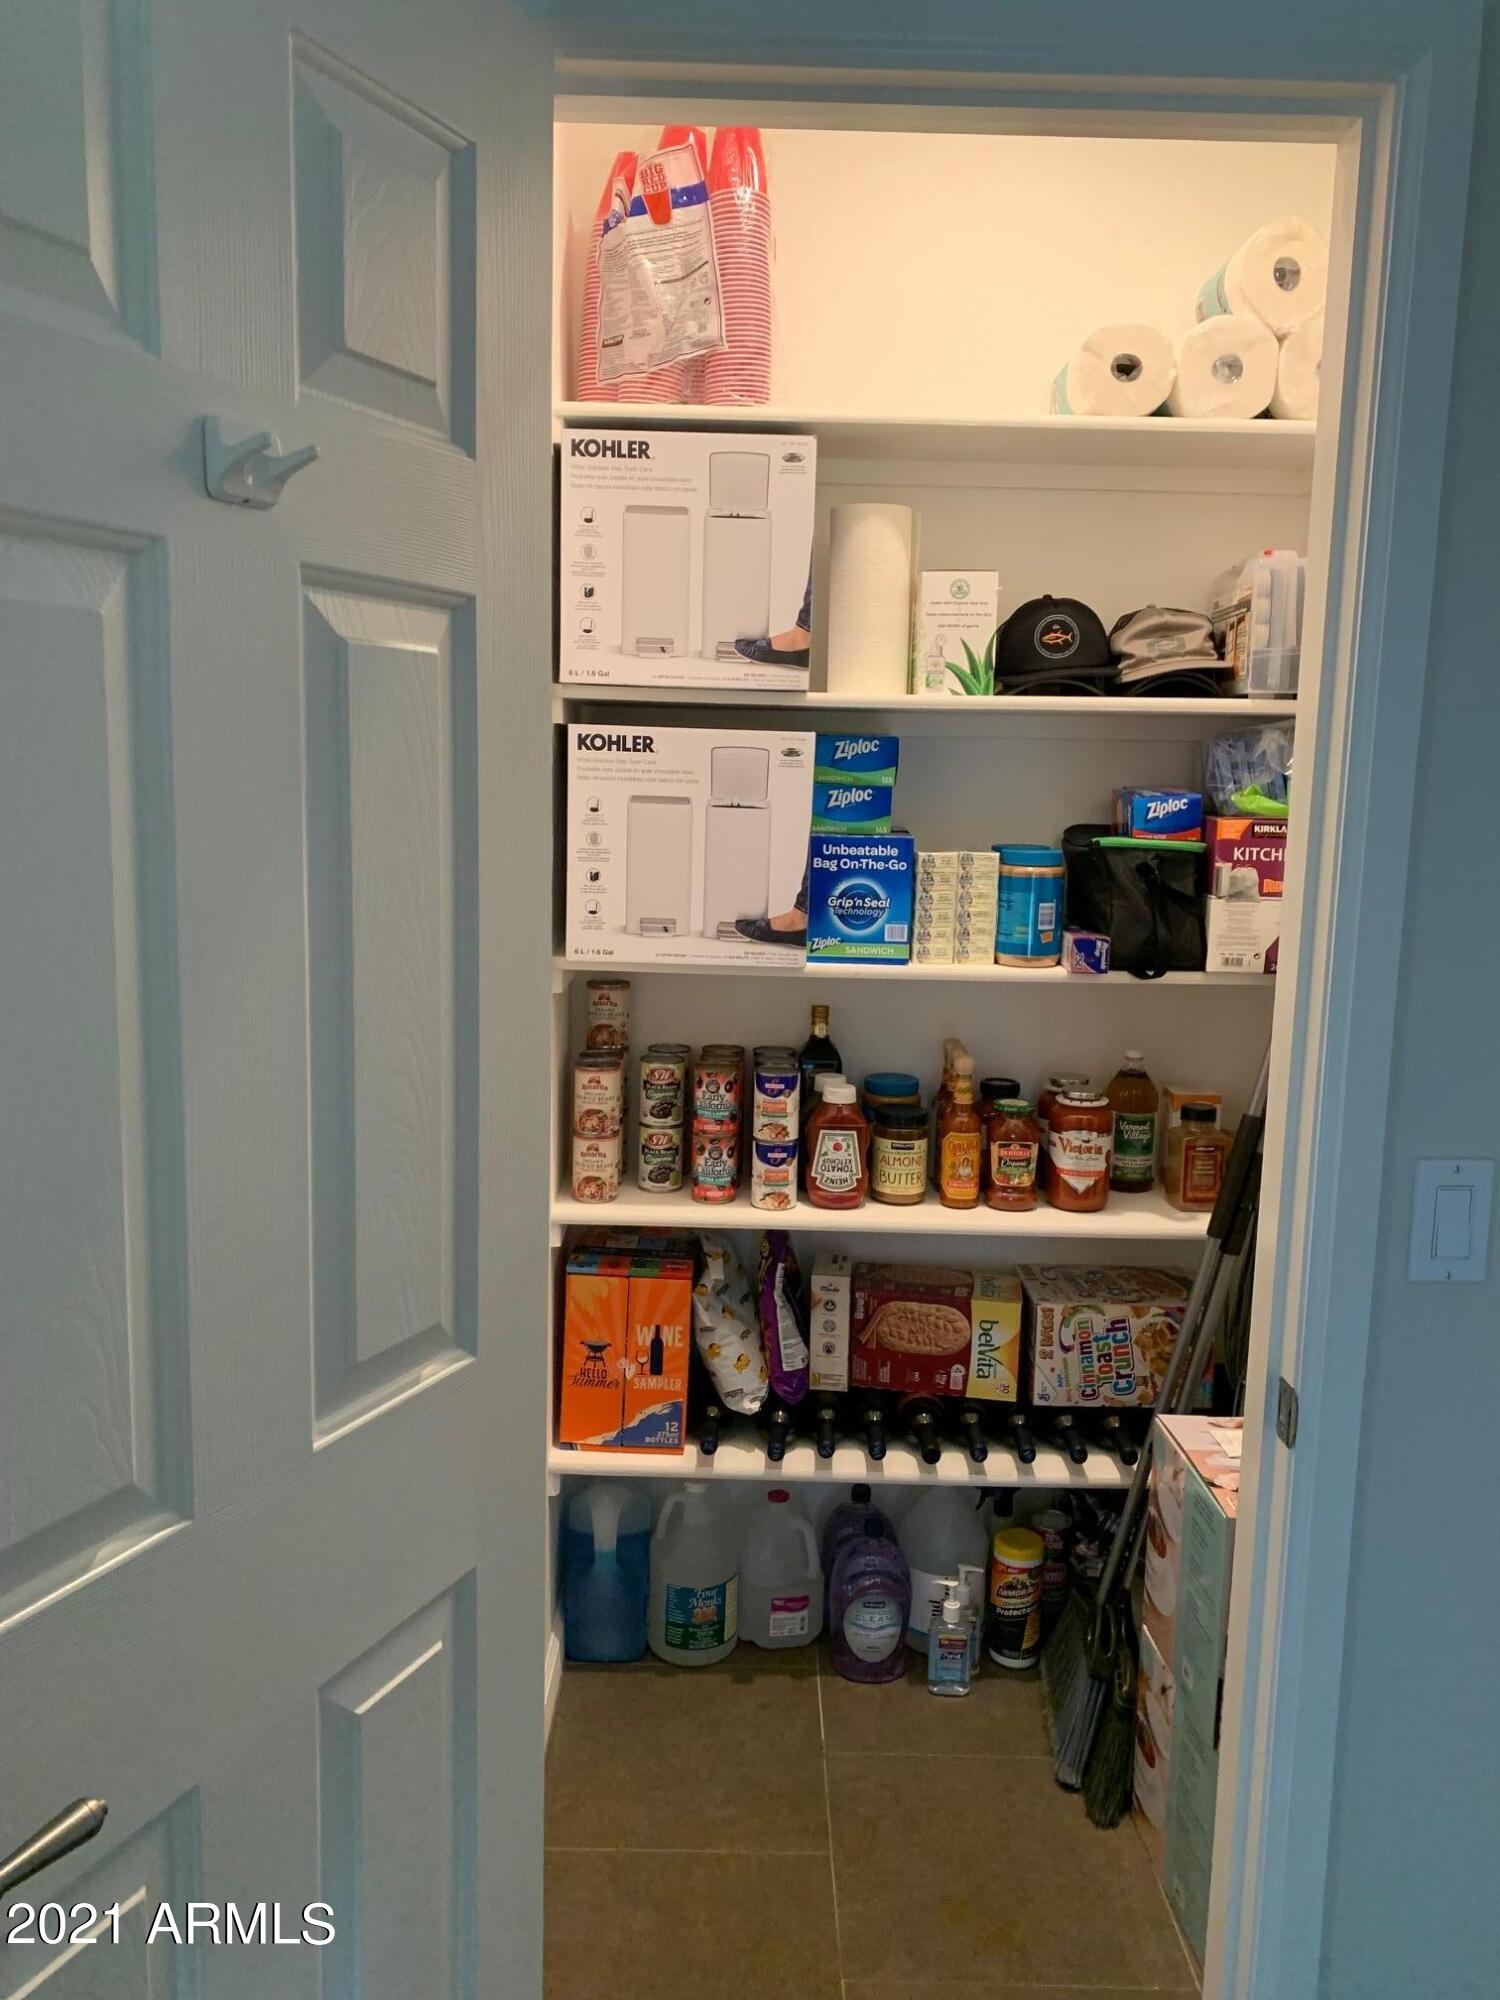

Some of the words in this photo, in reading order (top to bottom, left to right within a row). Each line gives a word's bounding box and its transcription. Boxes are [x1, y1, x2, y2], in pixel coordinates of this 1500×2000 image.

[640, 164, 664, 178] BIG
[642, 174, 666, 187] RED
[571, 438, 650, 459] KOHLER
[577, 733, 654, 753] KOHLER
[834, 738, 880, 760] Ziploc
[828, 788, 872, 808] Ziploc
[1147, 798, 1188, 820] Ziploc
[822, 844, 898, 856] Unbeatable
[813, 858, 838, 871] Bag
[840, 858, 907, 871] On-The-Go
[864, 898, 890, 908] Seal
[834, 908, 884, 918] Technology
[812, 936, 841, 950] Ziploc
[845, 946, 894, 955] SANDWICH
[703, 1092, 726, 1102] Early
[1120, 1120, 1151, 1131] Vermont
[1124, 1130, 1152, 1143] Village
[1059, 1136, 1102, 1155] Victoria
[705, 1159, 727, 1168] Early
[880, 1155, 922, 1167] ALMOND
[820, 1164, 853, 1173] TOMATO
[824, 1176, 848, 1186] HEINZ
[879, 1170, 922, 1185] BUTTER
[976, 1320, 1004, 1379] belVita
[580, 1368, 607, 1380] HELLO
[569, 1375, 620, 1389] Summer
[634, 1378, 682, 1392] SAMPLER
[665, 1422, 678, 1432] 12
[694, 1588, 718, 1600] Four
[688, 1596, 722, 1608] Monks
